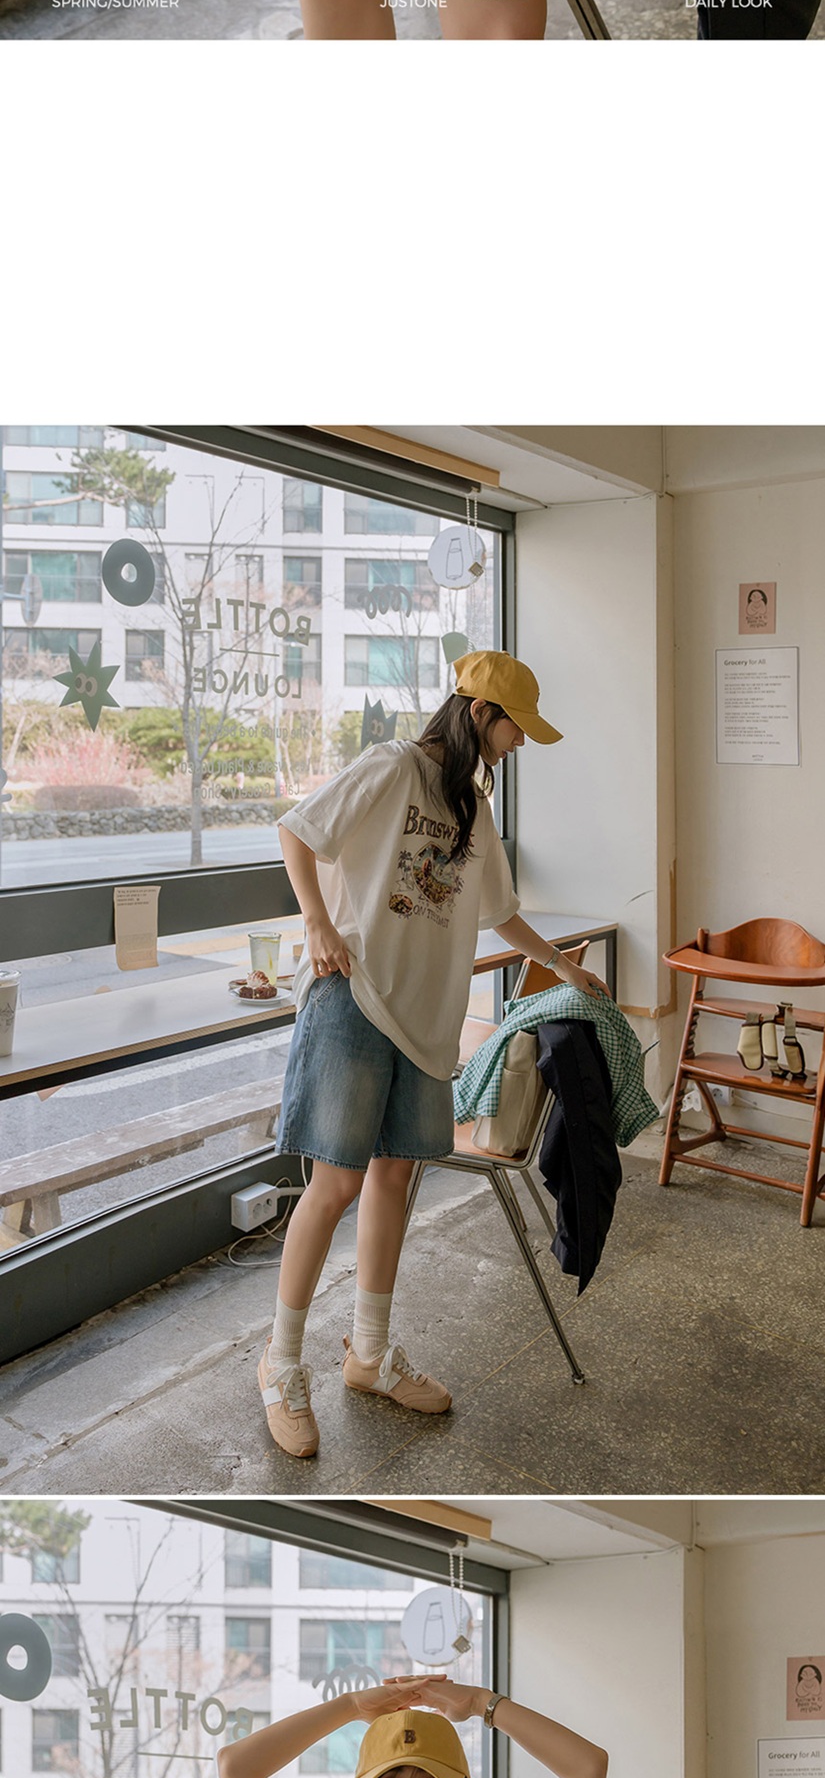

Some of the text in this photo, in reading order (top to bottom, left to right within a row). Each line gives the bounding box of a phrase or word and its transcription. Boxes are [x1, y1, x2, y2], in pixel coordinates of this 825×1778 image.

[404, 1729, 416, 1744] B
[768, 1750, 821, 1762] Grocery for All
